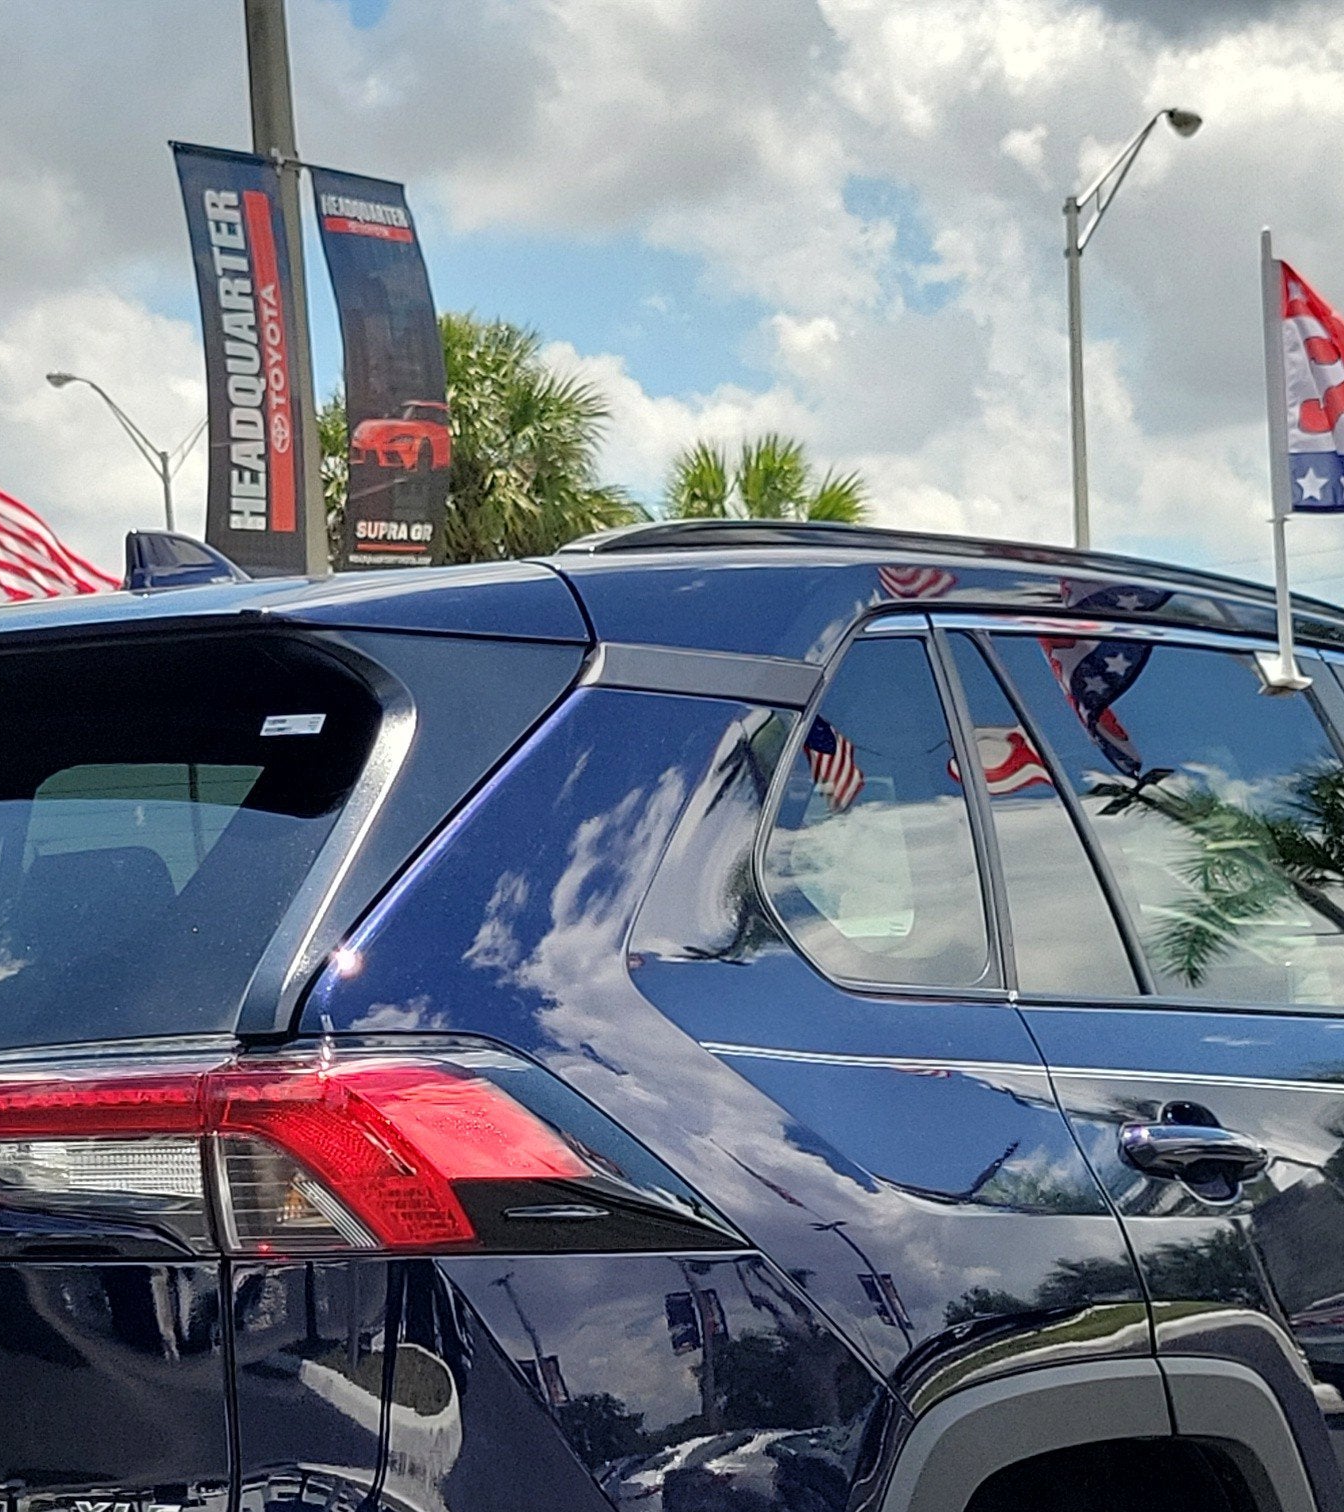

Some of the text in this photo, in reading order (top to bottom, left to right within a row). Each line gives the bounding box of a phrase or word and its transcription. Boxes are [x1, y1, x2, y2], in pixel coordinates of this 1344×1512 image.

[204, 189, 267, 531] HEADQUARTER
[260, 284, 289, 410] TOYOTA
[355, 521, 408, 540] SUPRA
